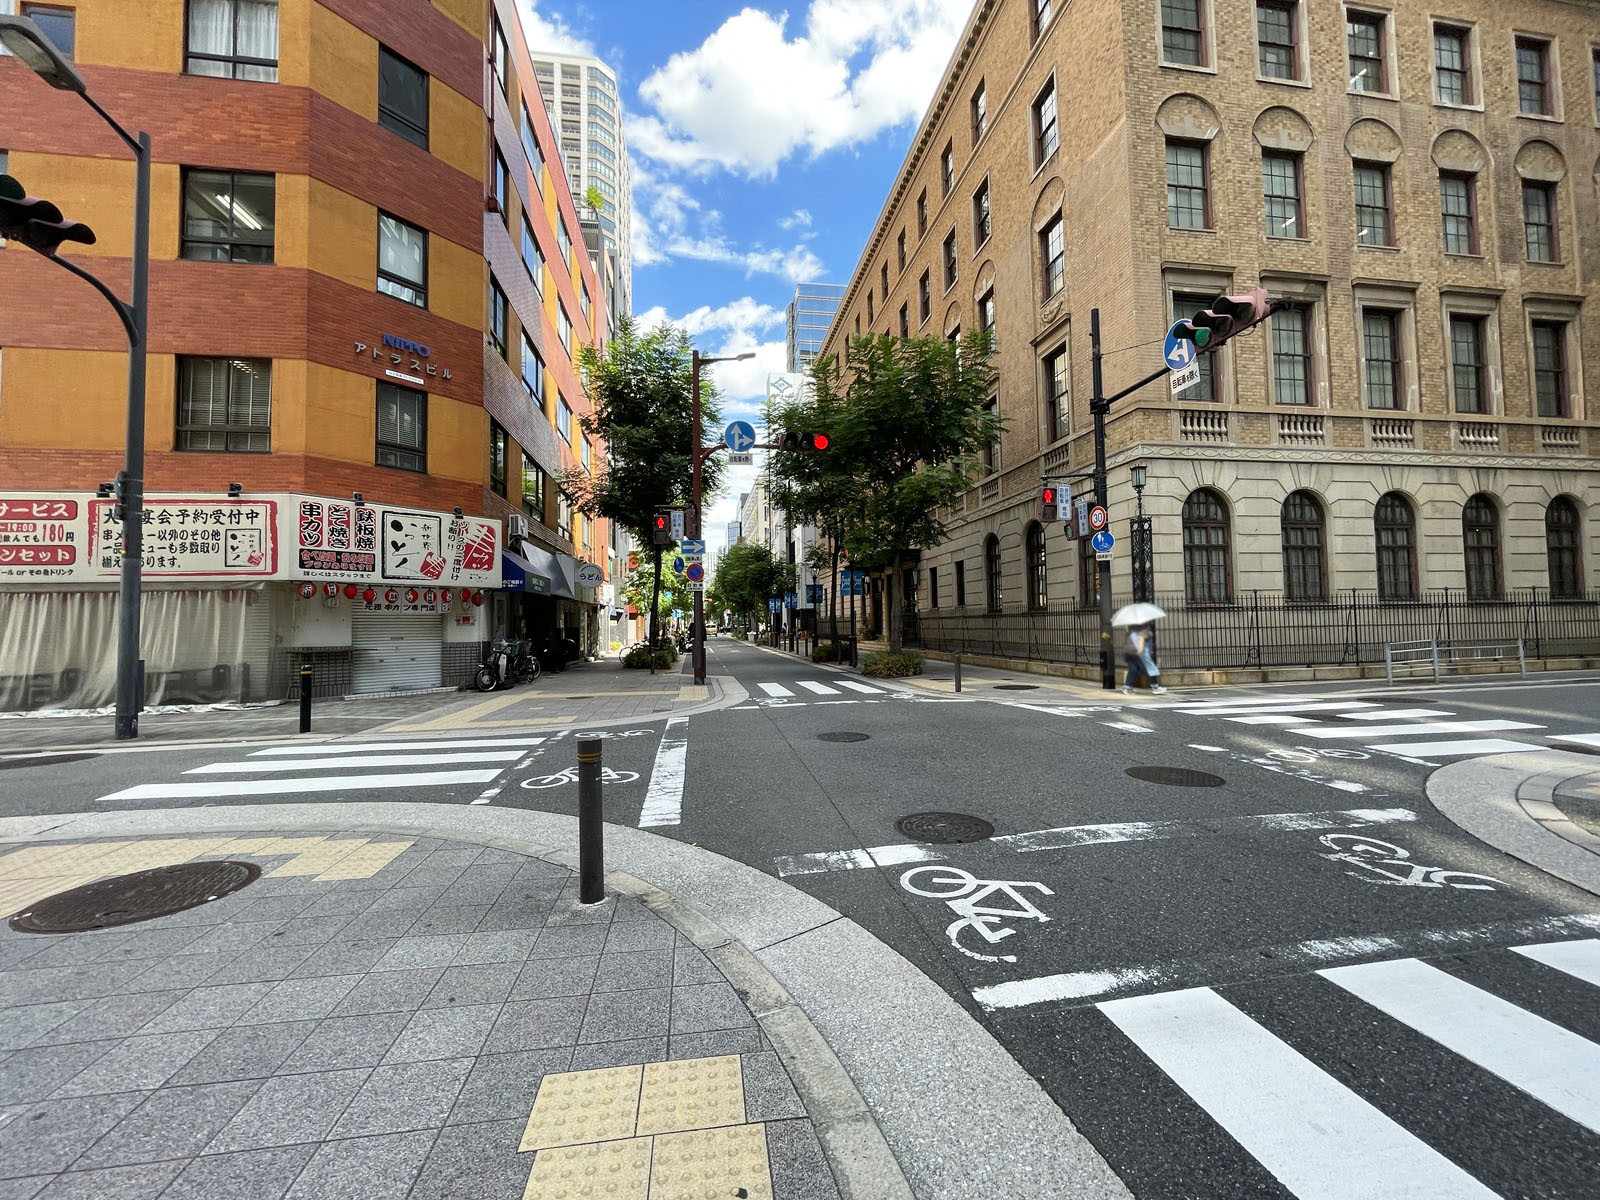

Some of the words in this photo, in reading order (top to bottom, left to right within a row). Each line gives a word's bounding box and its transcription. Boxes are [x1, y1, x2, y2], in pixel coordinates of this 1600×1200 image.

[354, 341, 453, 379] アトラスビル
[103, 508, 260, 525] 大宴会予約受付中
[302, 503, 321, 546] 串カツ
[1093, 512, 1103, 524] 30
[103, 529, 221, 541] 串メー以外のその他
[329, 505, 350, 549] どて焼き
[356, 509, 375, 550] 鉄板焼
[102, 542, 220, 554] 一品ューも多数取り
[451, 520, 468, 580] ソースの二度付け
[102, 555, 181, 568] 揃えります。
[579, 573, 603, 581] うどん
